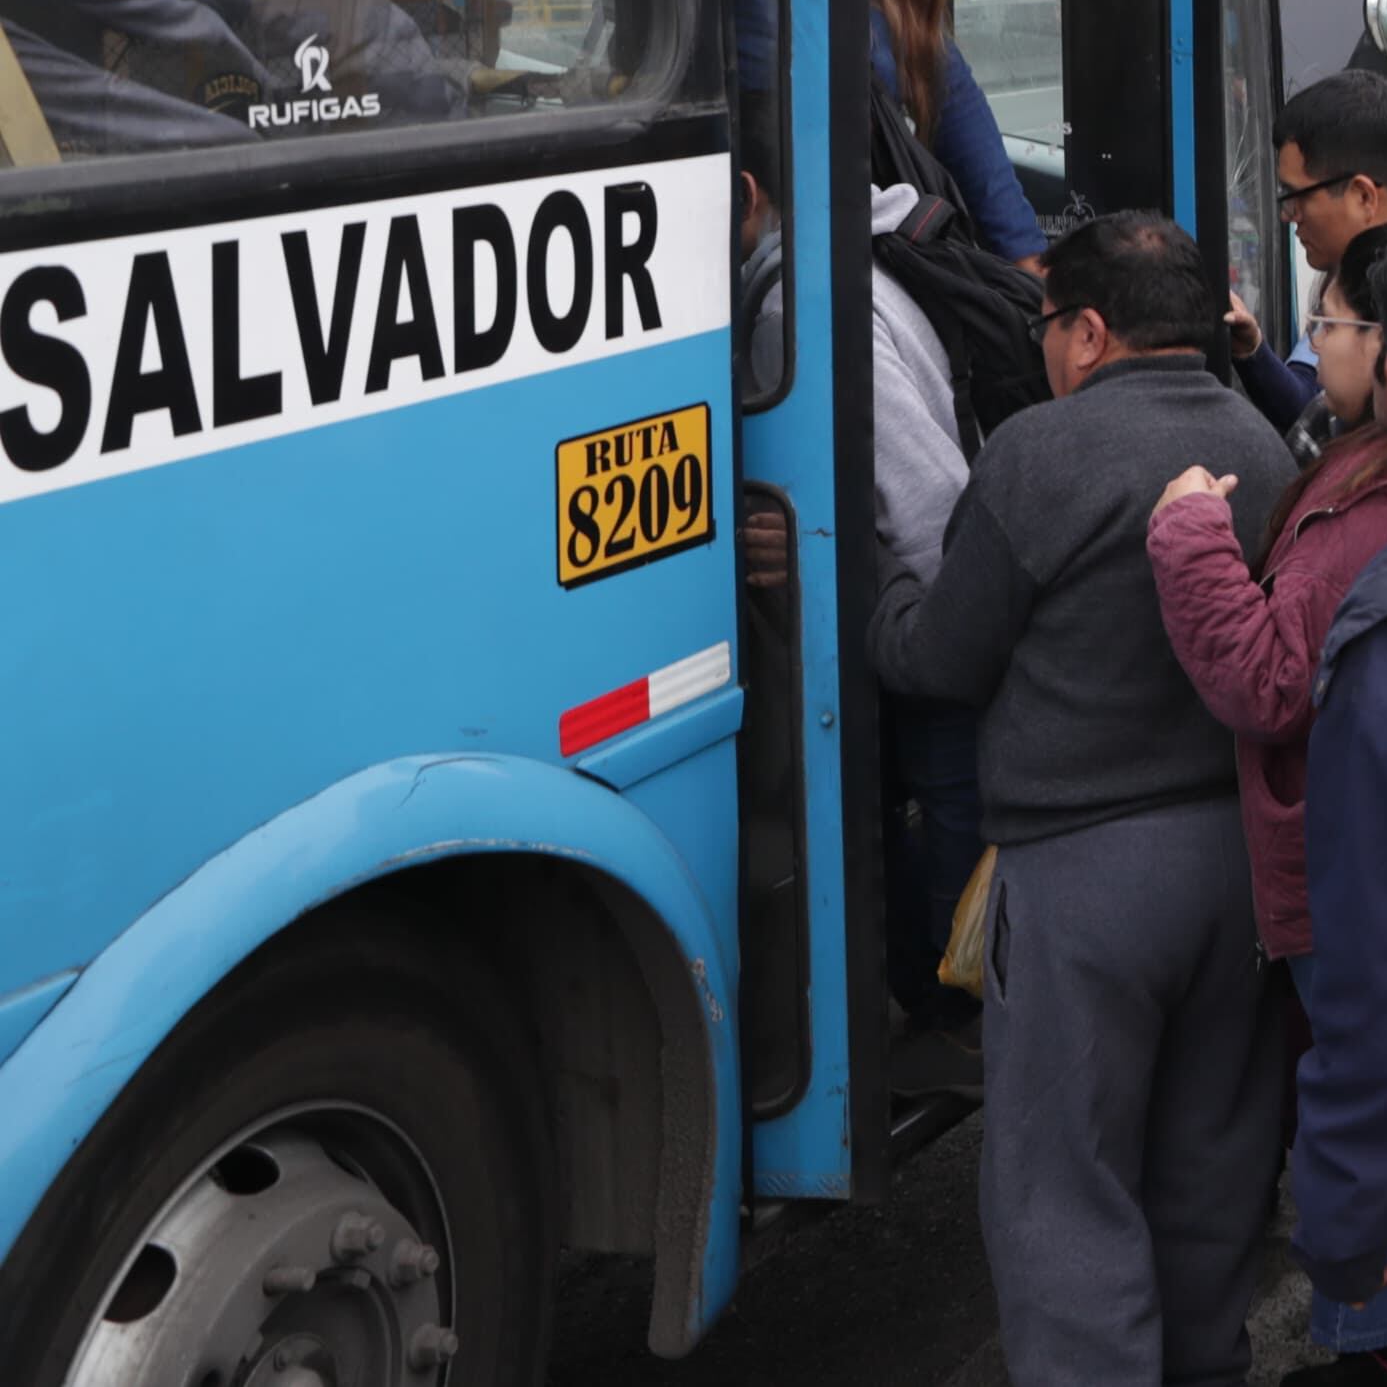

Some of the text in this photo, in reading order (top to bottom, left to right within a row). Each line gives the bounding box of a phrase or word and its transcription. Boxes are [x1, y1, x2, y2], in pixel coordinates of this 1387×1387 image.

[248, 93, 381, 129] RUFIGAS
[0, 181, 663, 472] SALVADOR
[583, 420, 680, 478] RUTA
[565, 454, 705, 569] 8209
